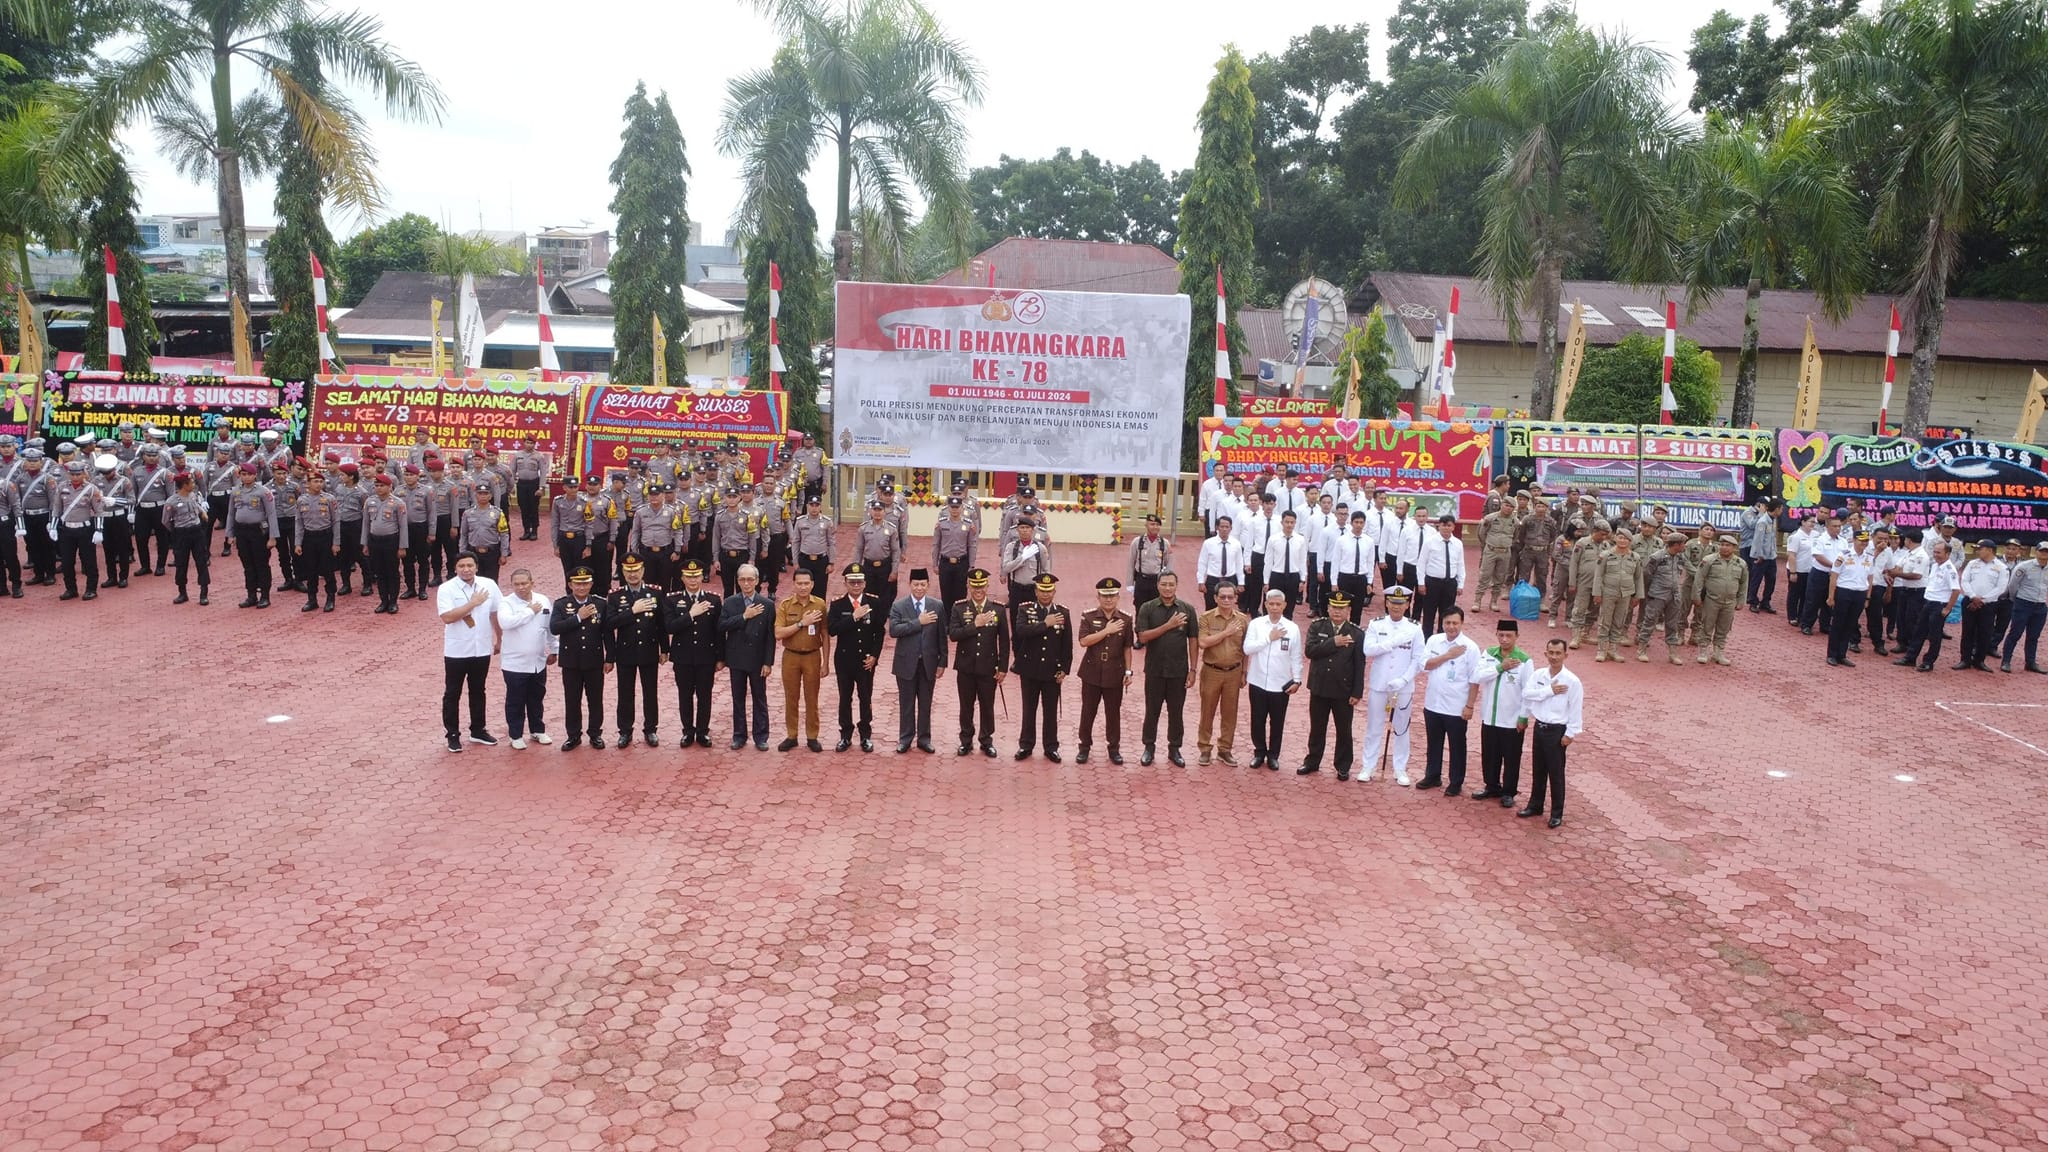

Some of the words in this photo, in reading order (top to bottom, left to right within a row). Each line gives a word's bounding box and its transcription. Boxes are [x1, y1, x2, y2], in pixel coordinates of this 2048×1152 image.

[896, 327, 951, 352] HARI
[959, 329, 1127, 360] BHAYANGKARA
[972, 359, 1000, 382] KE
[1021, 361, 1048, 385] 78
[1803, 344, 1816, 404] POLRES
[81, 385, 169, 404] SELAMAT
[173, 388, 186, 404] &
[193, 387, 268, 406] SUKSES
[325, 390, 401, 406] SELAMAT
[403, 390, 438, 406] HARI
[442, 392, 559, 415] BHAYANGKARA
[602, 393, 672, 410] SELAMAT
[695, 397, 750, 414] SUKSES
[948, 387, 959, 396] 01
[961, 388, 980, 397] JULI
[983, 389, 1006, 398] 1946
[1013, 390, 1026, 399] 01
[1027, 391, 1046, 400] JULI
[1047, 392, 1071, 401] 2024
[860, 400, 887, 408] POLRI
[889, 401, 924, 410] PRESISI
[926, 402, 984, 413] MENDUKUNG
[986, 405, 1043, 415] PERCEPATAN
[1045, 407, 1114, 418] TRANSFORMASI
[1117, 410, 1159, 420] EKONOMI
[1250, 398, 1329, 415] SELAMAT
[53, 411, 82, 424] HUT
[83, 412, 181, 428] BHAYANGKARA
[472, 412, 518, 428] 2024
[595, 417, 640, 427] DIRGAHAYU
[641, 419, 696, 429] BHAYANGKARA
[722, 424, 748, 432] TAHUN
[869, 411, 892, 420] YANG
[894, 412, 936, 421] INKLUSIF
[937, 413, 956, 422] DAN
[958, 414, 1031, 426] BERKELANJUTAN
[1033, 418, 1070, 428] MENUJU
[1072, 420, 1121, 430] INDONESIA
[1123, 422, 1149, 431] EMAS
[49, 425, 80, 438] POLRI
[318, 422, 358, 433] POLRI
[362, 423, 398, 434] YANG
[402, 424, 455, 437] PRSISI
[579, 424, 601, 432] POLRI
[602, 425, 632, 434] PRESISI
[632, 427, 681, 438] MENDUKUNG
[681, 430, 728, 440] PERCEPATAN
[591, 433, 626, 442] EKONOMI
[1219, 425, 1343, 450] SELAMAT
[1352, 428, 1442, 454] HUT
[1538, 437, 1631, 455] SELAMAT
[1645, 440, 1657, 453] &
[1670, 441, 1748, 459] SUKSES
[1401, 451, 1435, 470] 78
[1844, 443, 1912, 464] Selamat
[1396, 468, 1446, 480] PRESISI
[1836, 476, 1877, 490] HARI
[1883, 479, 2003, 496] BHAYANGKARA
[1680, 506, 1706, 524] NIAS
[1928, 501, 1974, 514] JAYA
